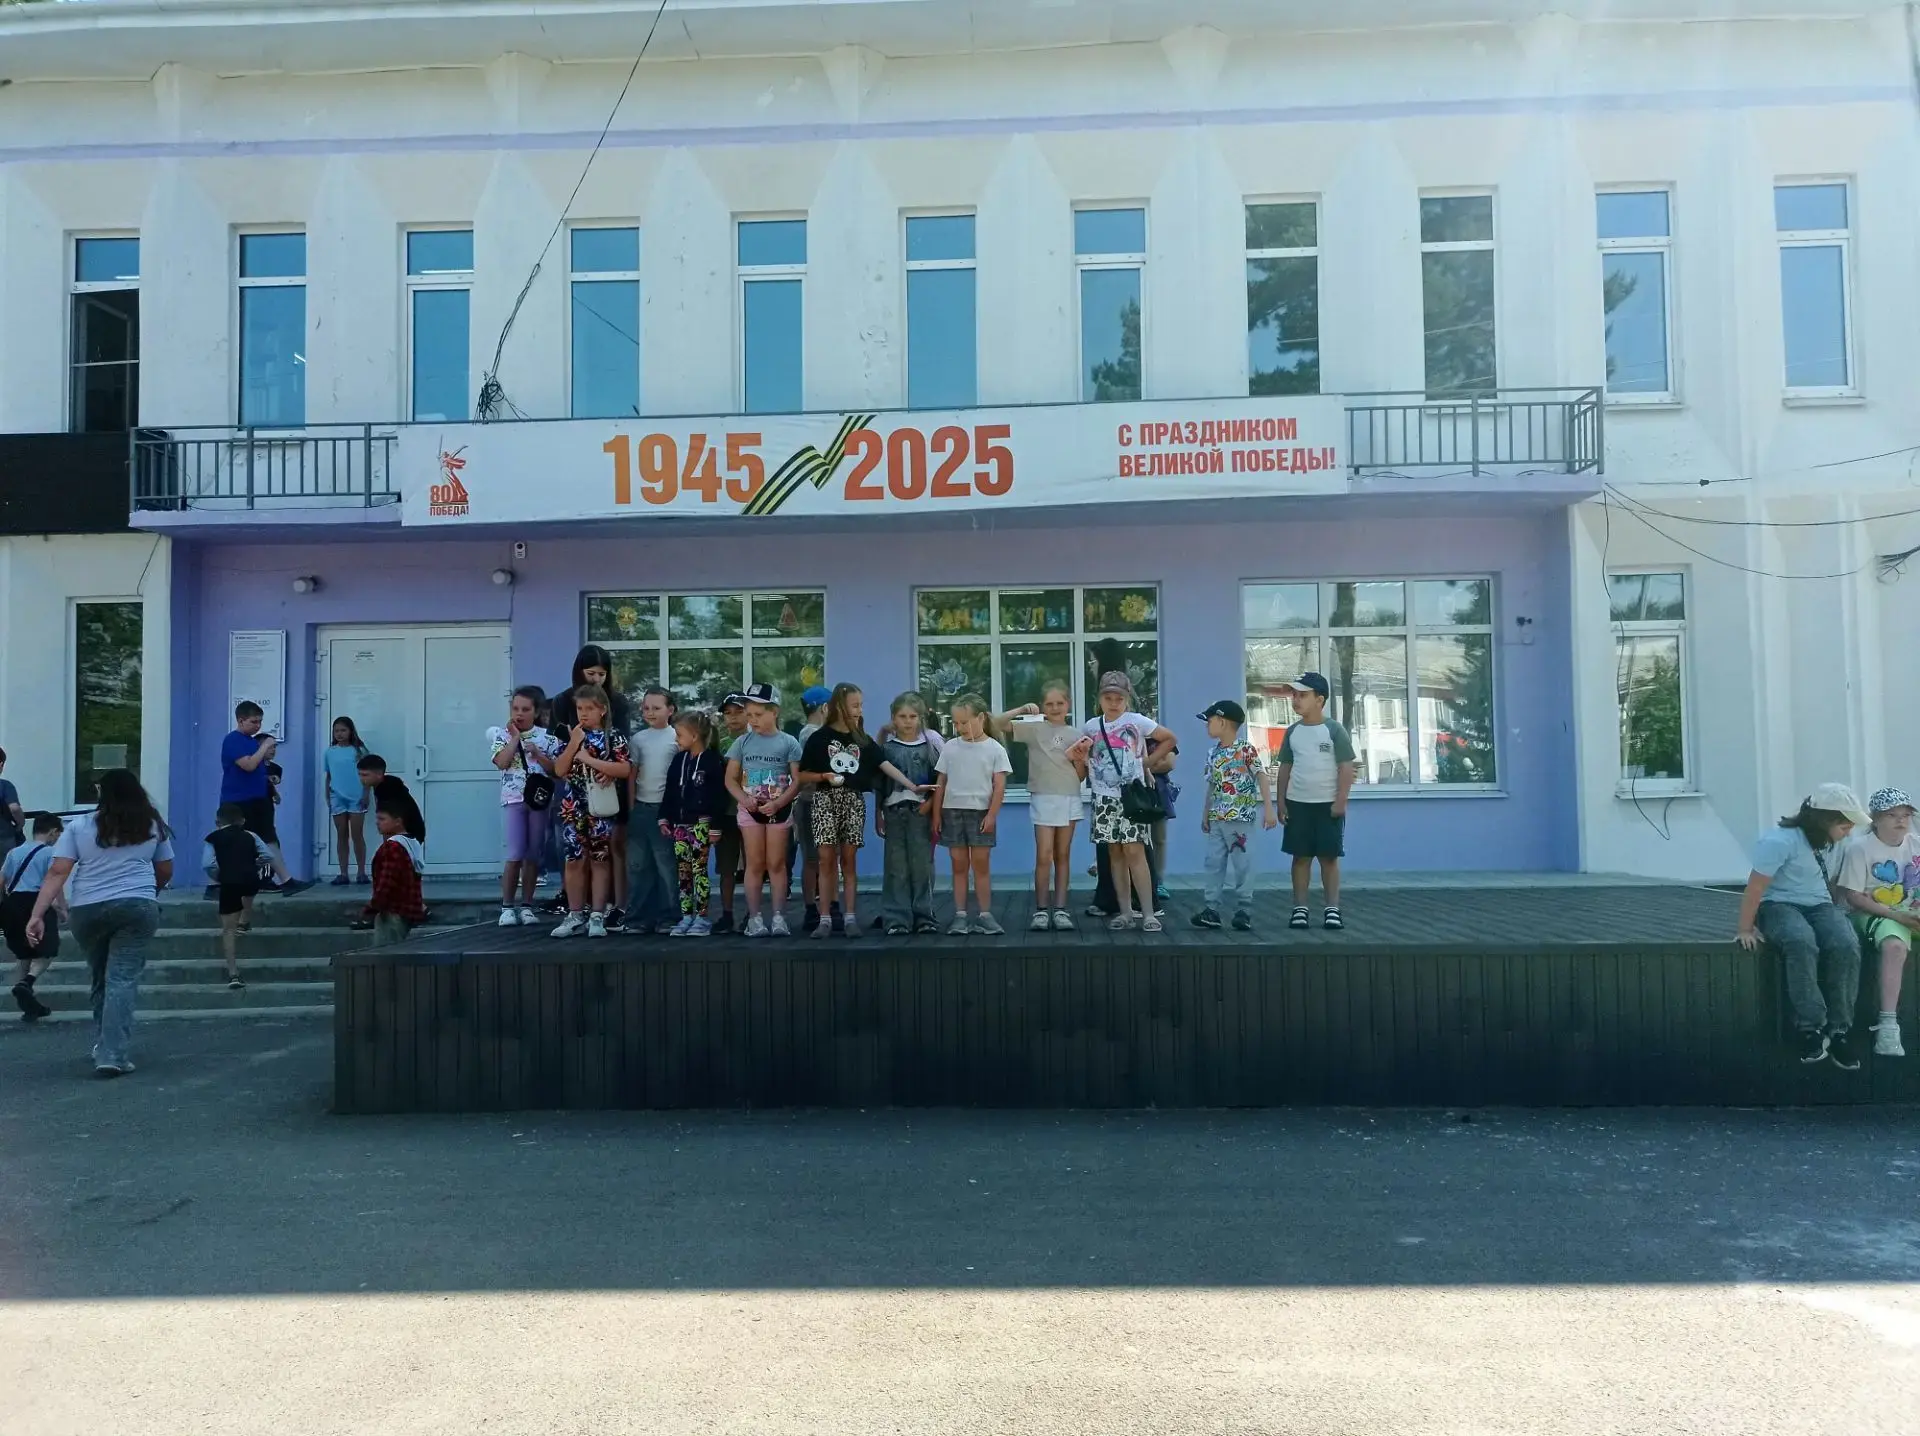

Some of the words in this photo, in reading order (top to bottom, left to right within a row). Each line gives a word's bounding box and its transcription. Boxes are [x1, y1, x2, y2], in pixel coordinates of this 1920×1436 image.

[1118, 424, 1132, 447] С
[1140, 418, 1297, 447] ПРАЗДНИКОМ
[603, 432, 765, 505] 1945
[844, 424, 1014, 500] 2025
[1119, 448, 1224, 477] ВЕЛИКОЙ
[1231, 447, 1336, 475] ПОБЕДЫ!
[430, 485, 452, 503] 80
[430, 505, 470, 517] ПОБЕДА!
